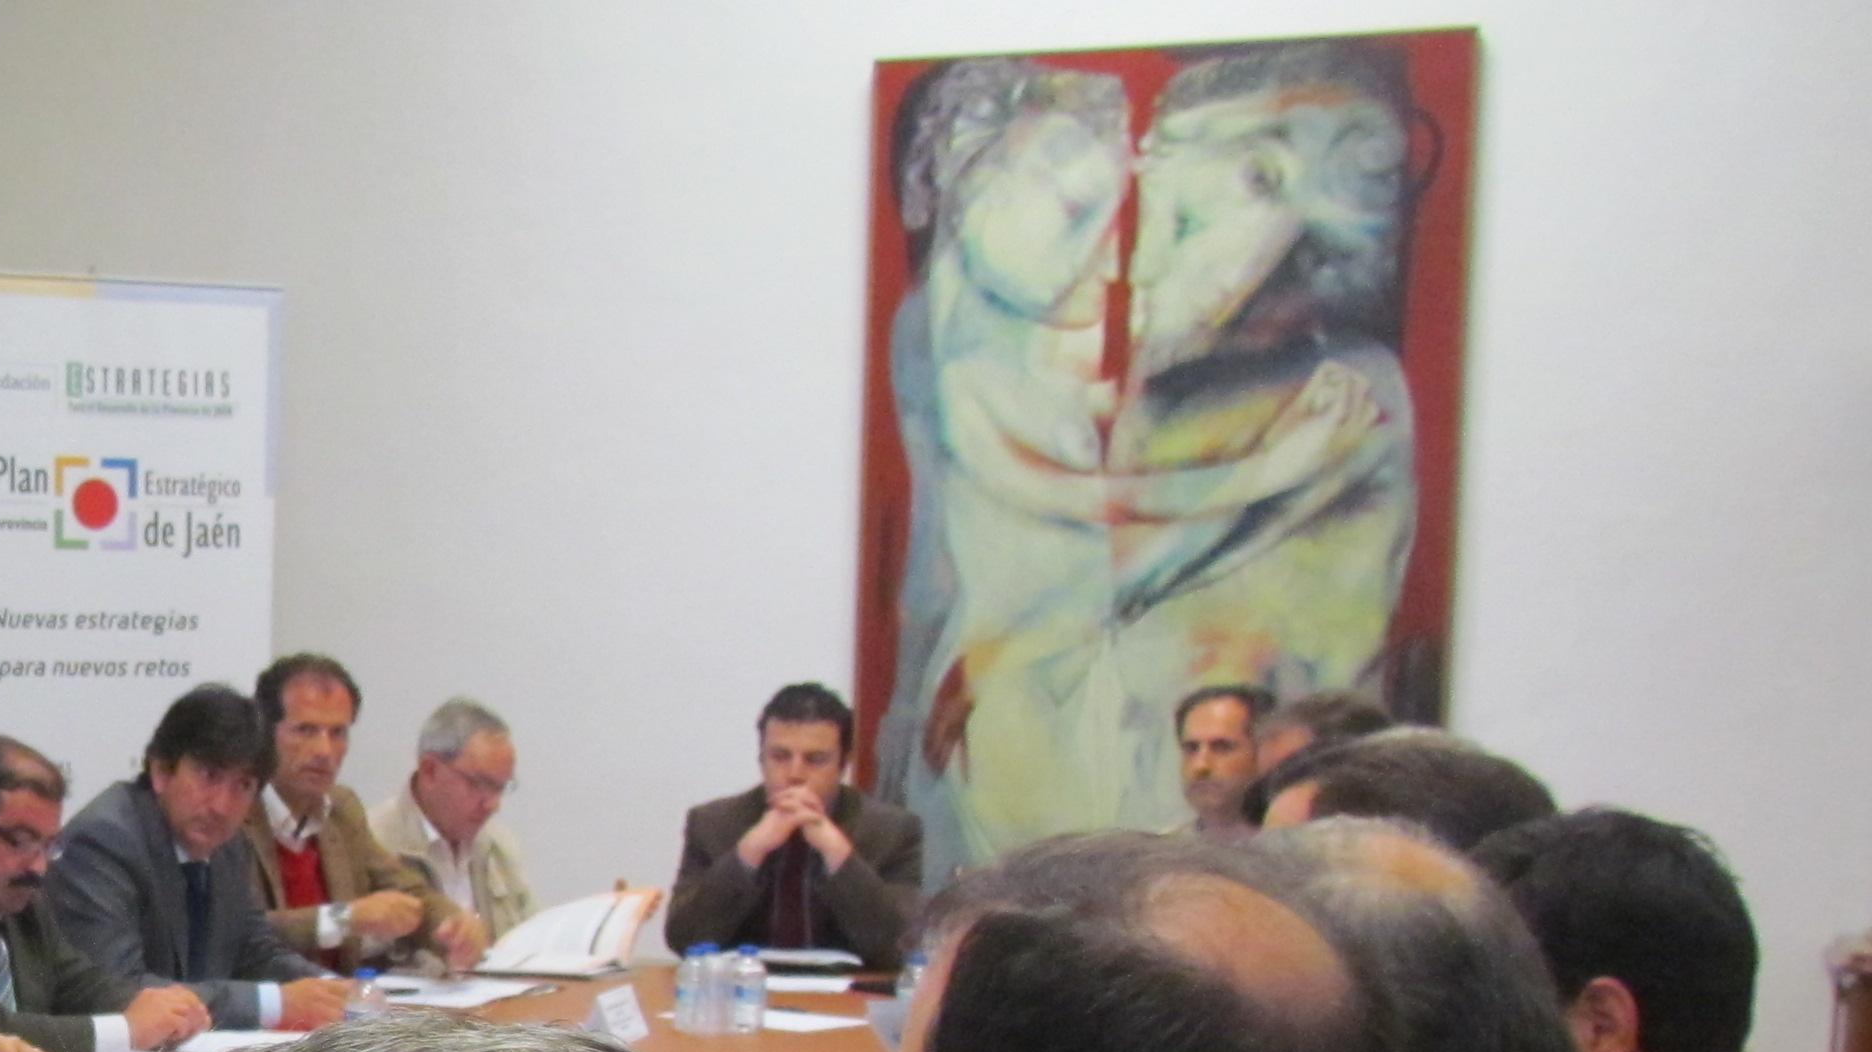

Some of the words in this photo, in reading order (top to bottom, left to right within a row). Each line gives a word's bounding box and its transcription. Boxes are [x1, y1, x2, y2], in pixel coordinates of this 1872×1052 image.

[66, 361, 231, 398] ESTRATEGIAS
[144, 471, 240, 504] Estratégico
[144, 511, 175, 547] de
[182, 511, 241, 558] Jaén
[75, 609, 200, 635] estrategias
[52, 661, 128, 677] nuevos
[134, 659, 191, 677] retos
